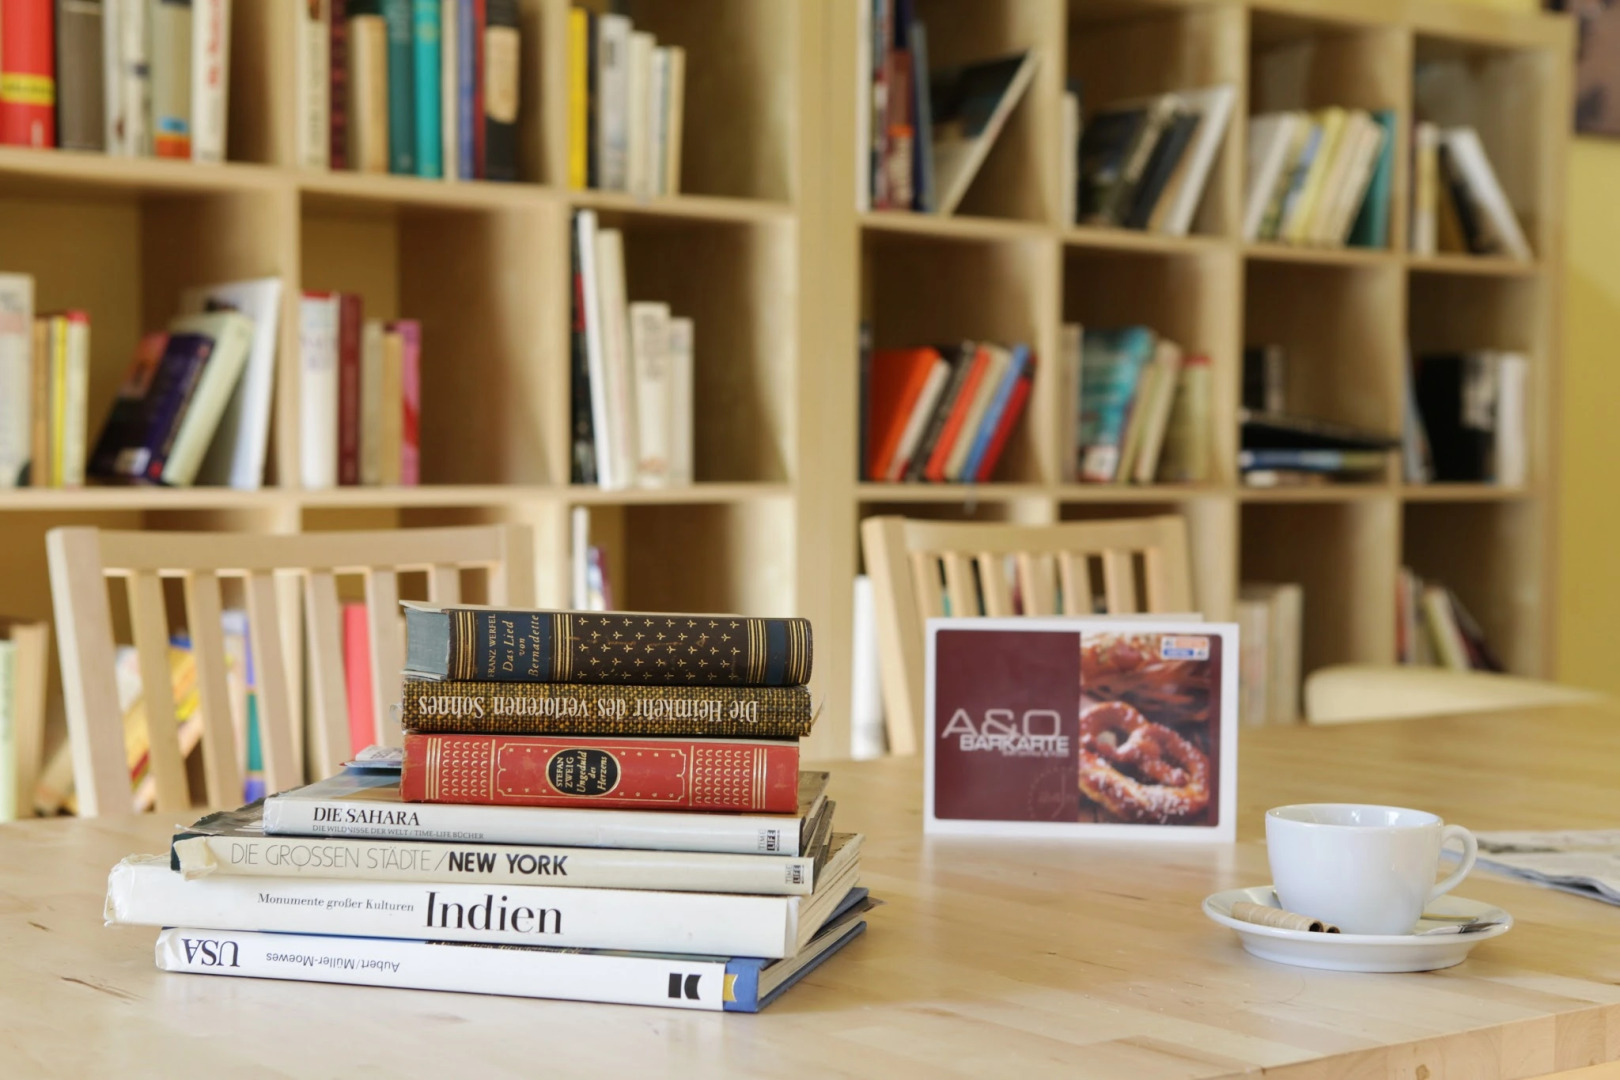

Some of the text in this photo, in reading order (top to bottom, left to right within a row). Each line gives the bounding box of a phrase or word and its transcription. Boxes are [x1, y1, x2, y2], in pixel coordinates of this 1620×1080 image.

[487, 613, 497, 678] FRANZ WERFEL
[501, 619, 515, 673] Das Lied
[518, 637, 526, 657] von
[527, 614, 540, 678] Bernadette
[418, 695, 759, 723] Die Heimkehr des verlorenen Sohnes
[941, 707, 1062, 739] A&O
[959, 733, 1070, 753] BARKARTE
[555, 756, 564, 788] STEFAN
[564, 756, 575, 788] ZWEIG
[576, 750, 588, 793] Ungeduld
[588, 766, 597, 779] des
[596, 756, 608, 791] Herzens
[312, 824, 325, 832] DIE
[327, 825, 369, 834] WILDNISSE
[371, 827, 387, 835] DER
[388, 828, 409, 836] WELT
[415, 829, 454, 838] TIME-LIFE
[452, 831, 484, 840] BÜCHER
[313, 806, 420, 826] DIE SAHARA
[767, 829, 776, 851] LIFE
[231, 842, 259, 865] DIE
[265, 844, 360, 869] GROSSEN
[367, 846, 431, 871] STÄDTE
[449, 851, 497, 873] NEW
[506, 853, 569, 876] YORK
[257, 892, 415, 912] Monumente großer Kulturen
[423, 890, 564, 935] Indien
[181, 938, 241, 968] USA
